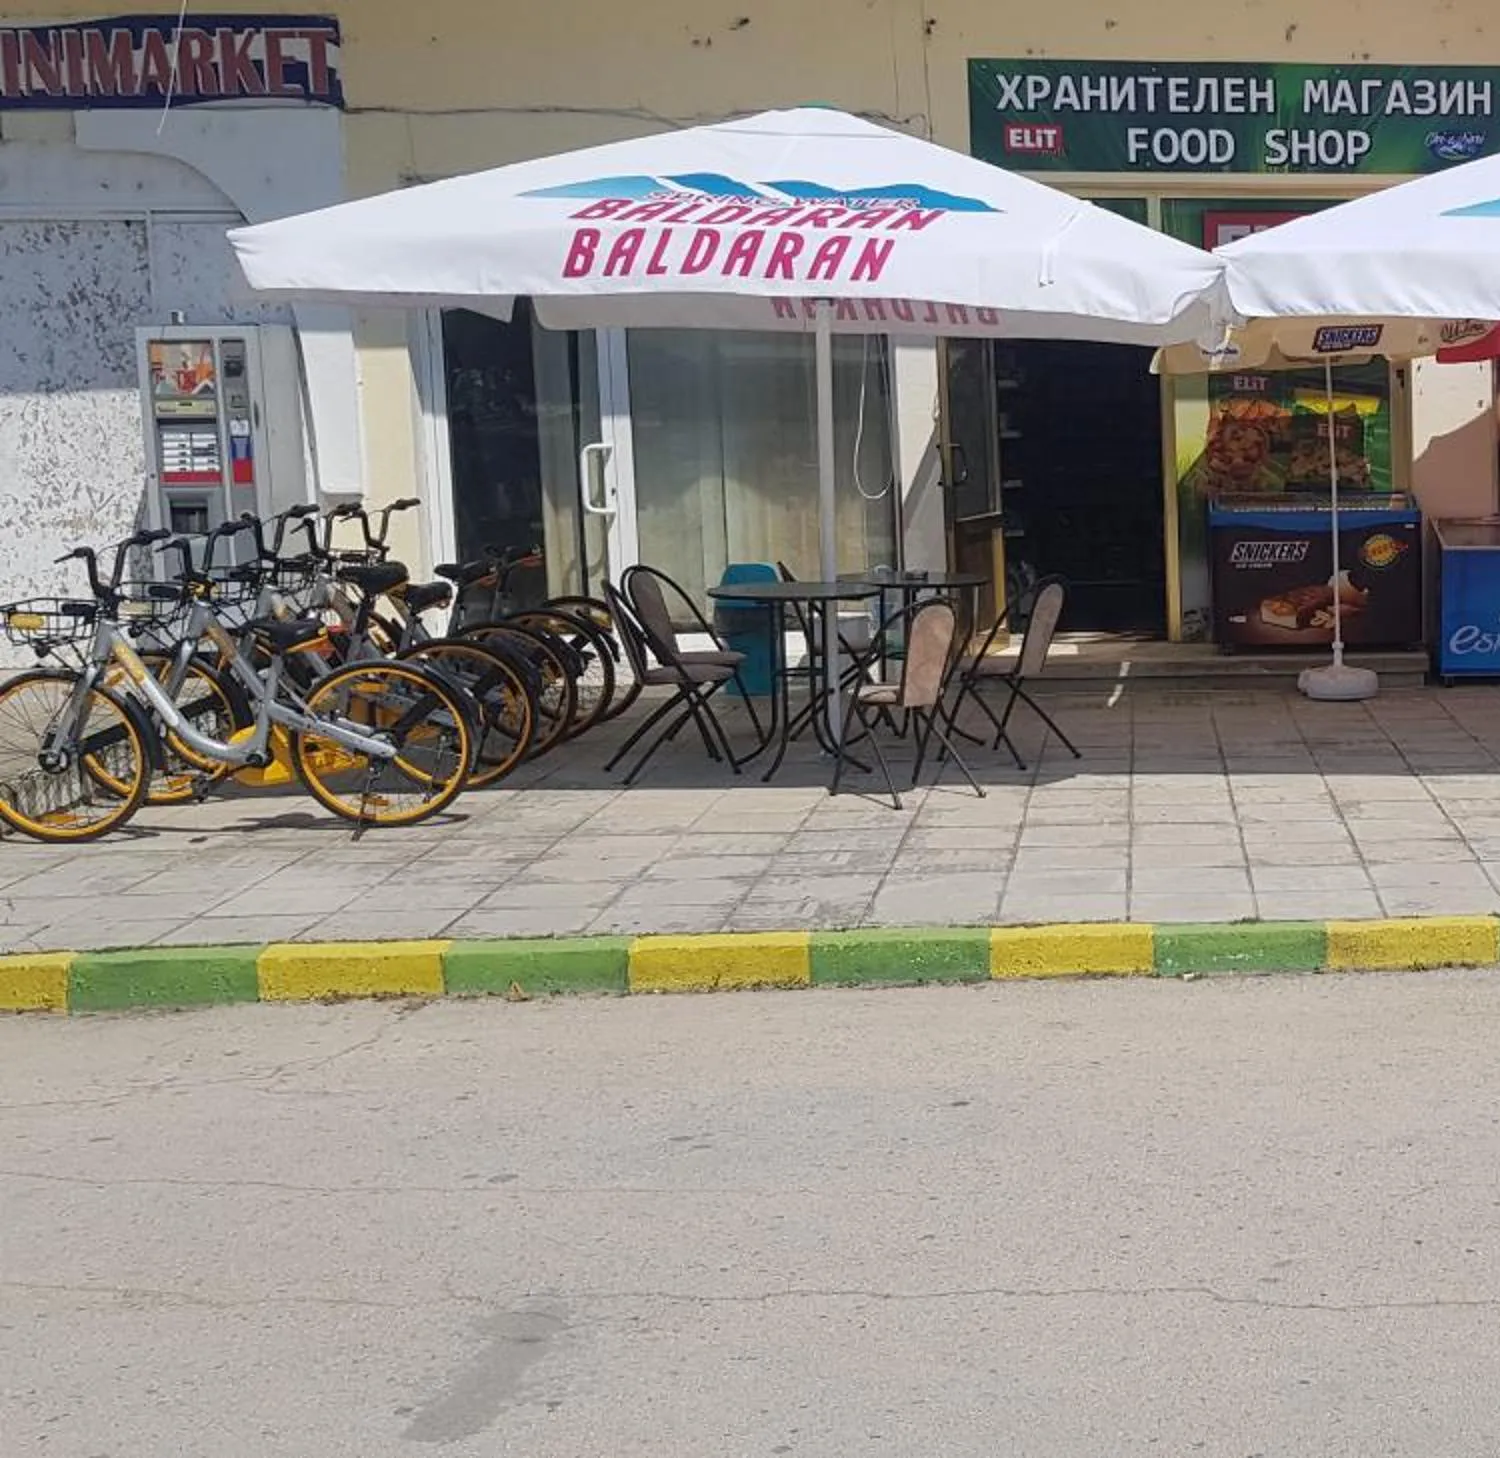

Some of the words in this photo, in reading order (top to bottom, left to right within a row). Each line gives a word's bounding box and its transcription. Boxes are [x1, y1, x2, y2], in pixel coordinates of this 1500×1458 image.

[996, 74, 1275, 114] ХРАНИТЕЛЕН
[1302, 79, 1491, 115] МАГАЗИН
[1126, 127, 1236, 165] FOOD
[1264, 129, 1371, 166] SHOP
[567, 198, 947, 231] BALDARAN
[562, 227, 895, 281] BALDARAN
[1318, 326, 1378, 344] SNICKERS
[1231, 541, 1309, 562] SNICKERS
